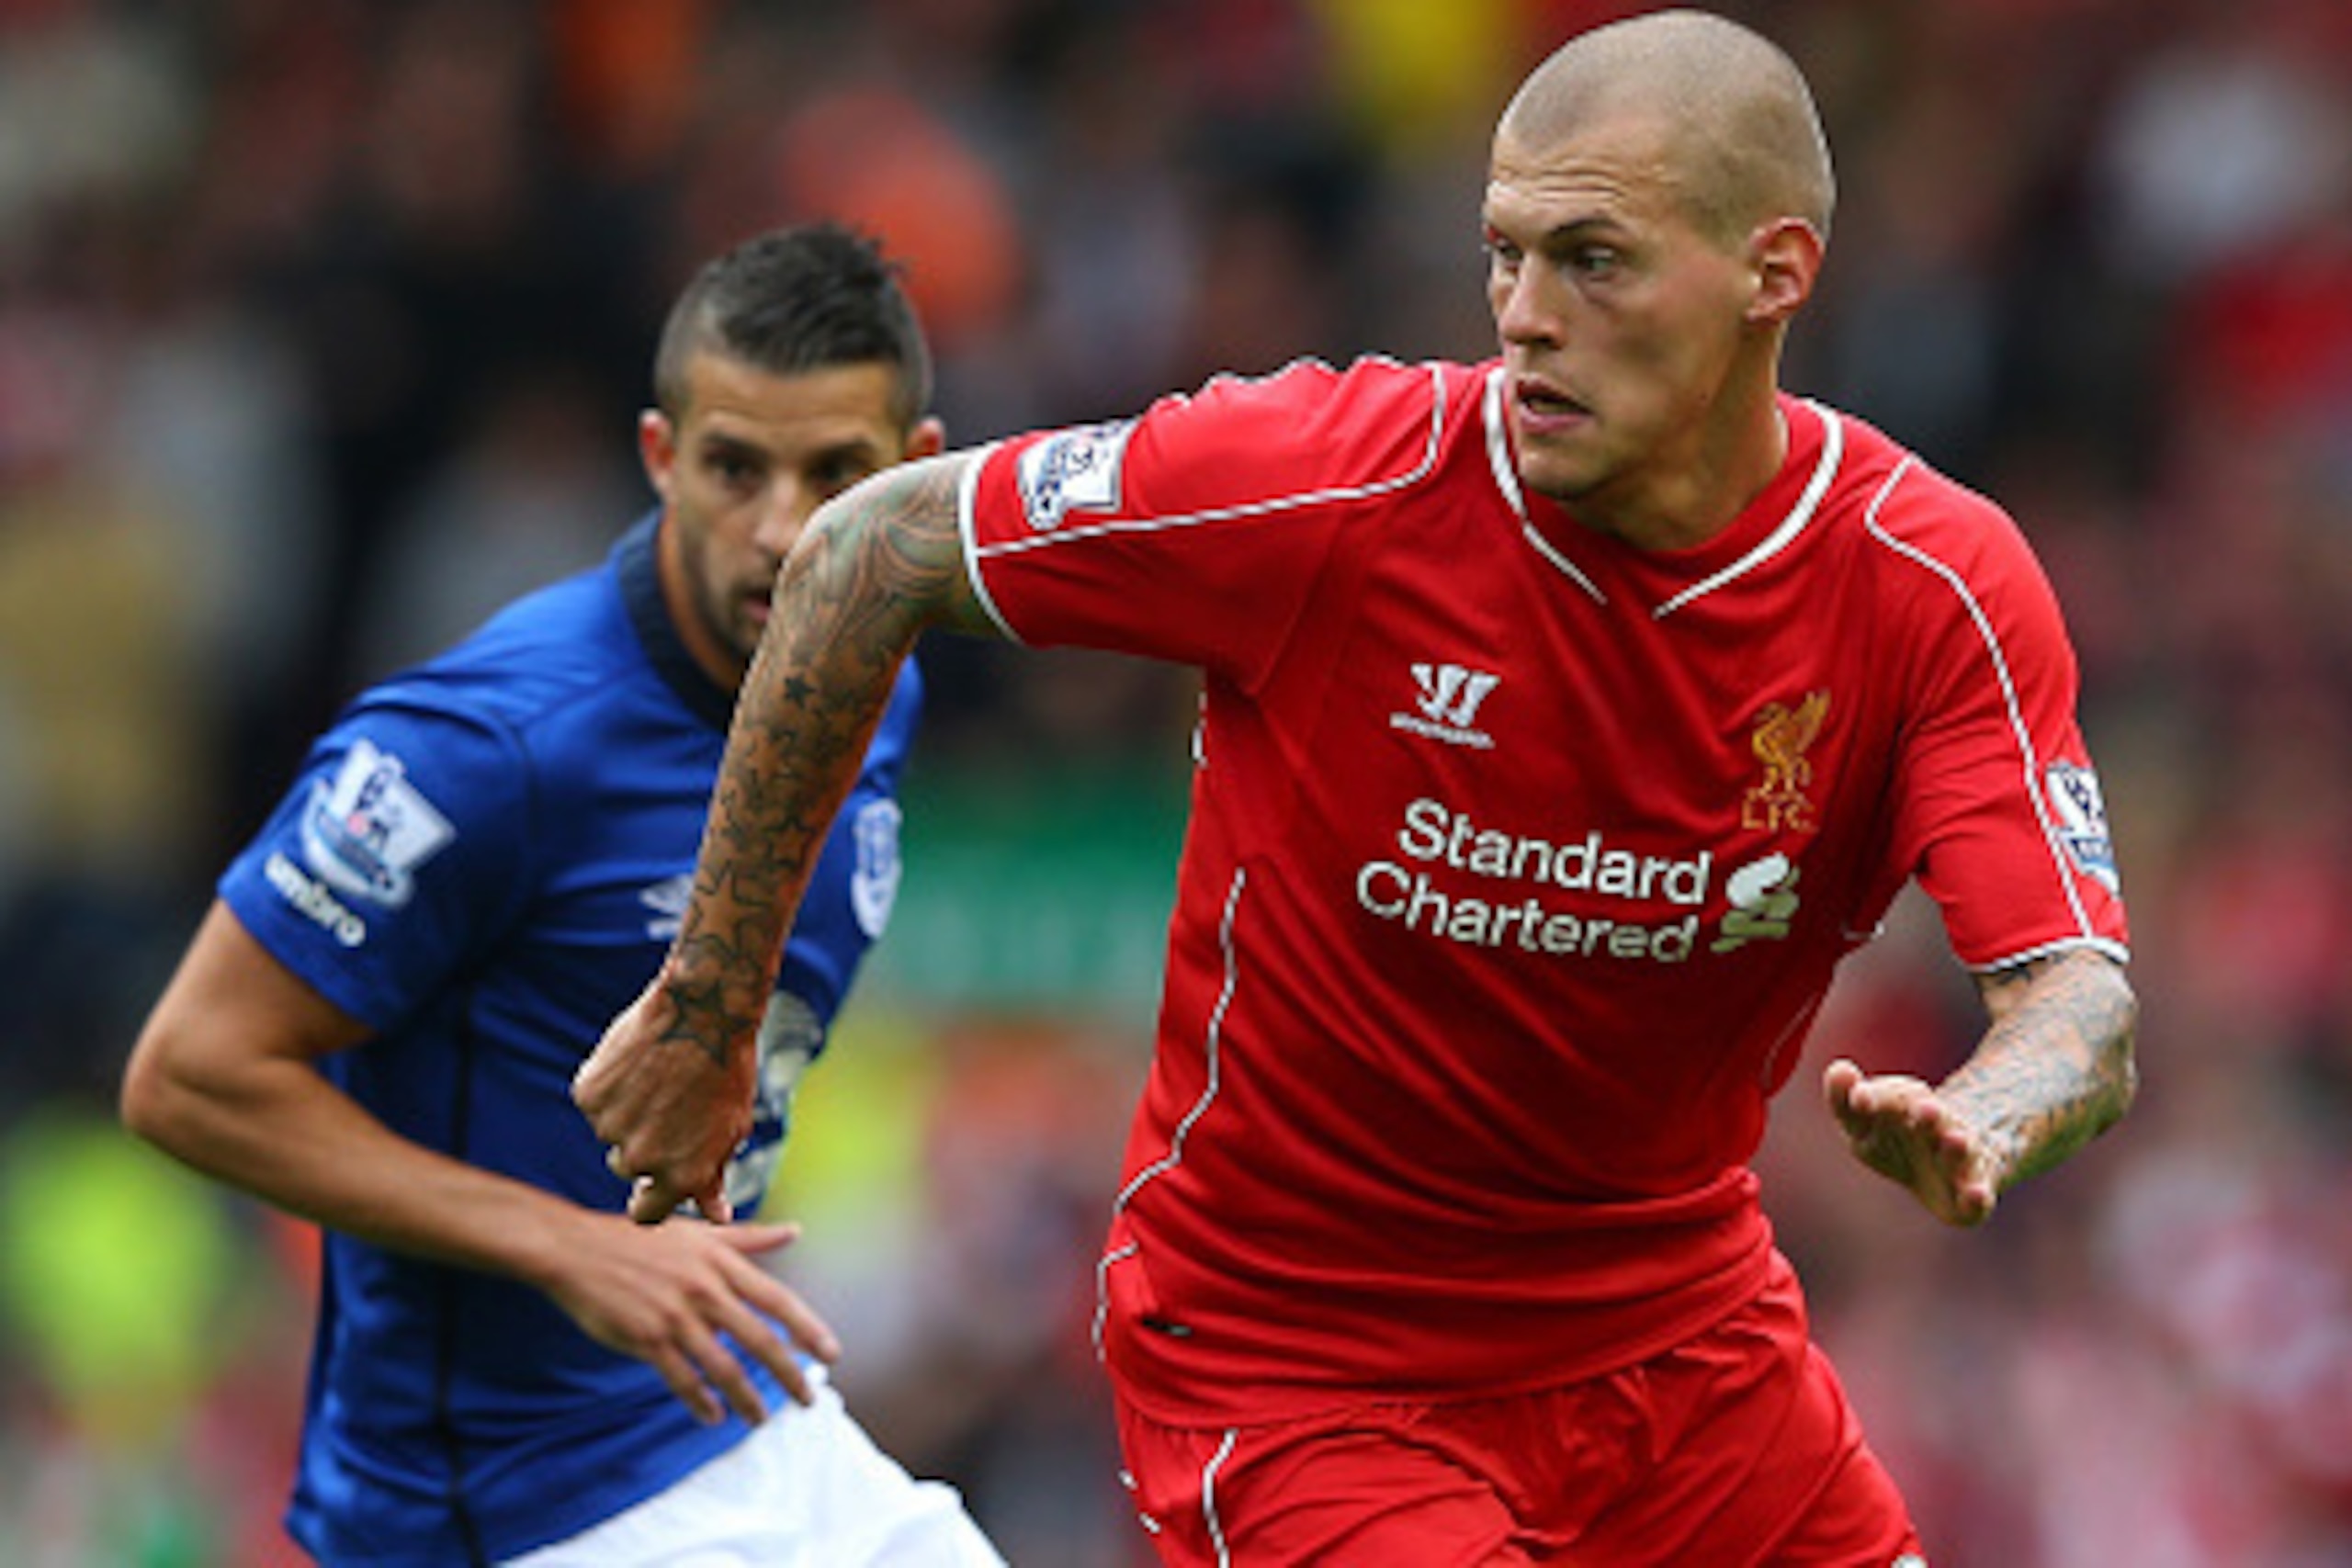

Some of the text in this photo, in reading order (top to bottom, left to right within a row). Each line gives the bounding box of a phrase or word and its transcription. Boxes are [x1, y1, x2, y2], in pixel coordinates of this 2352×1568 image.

[265, 852, 366, 947] umbro
[1397, 797, 1713, 905] Standard
[1356, 861, 1700, 962] Chartered
